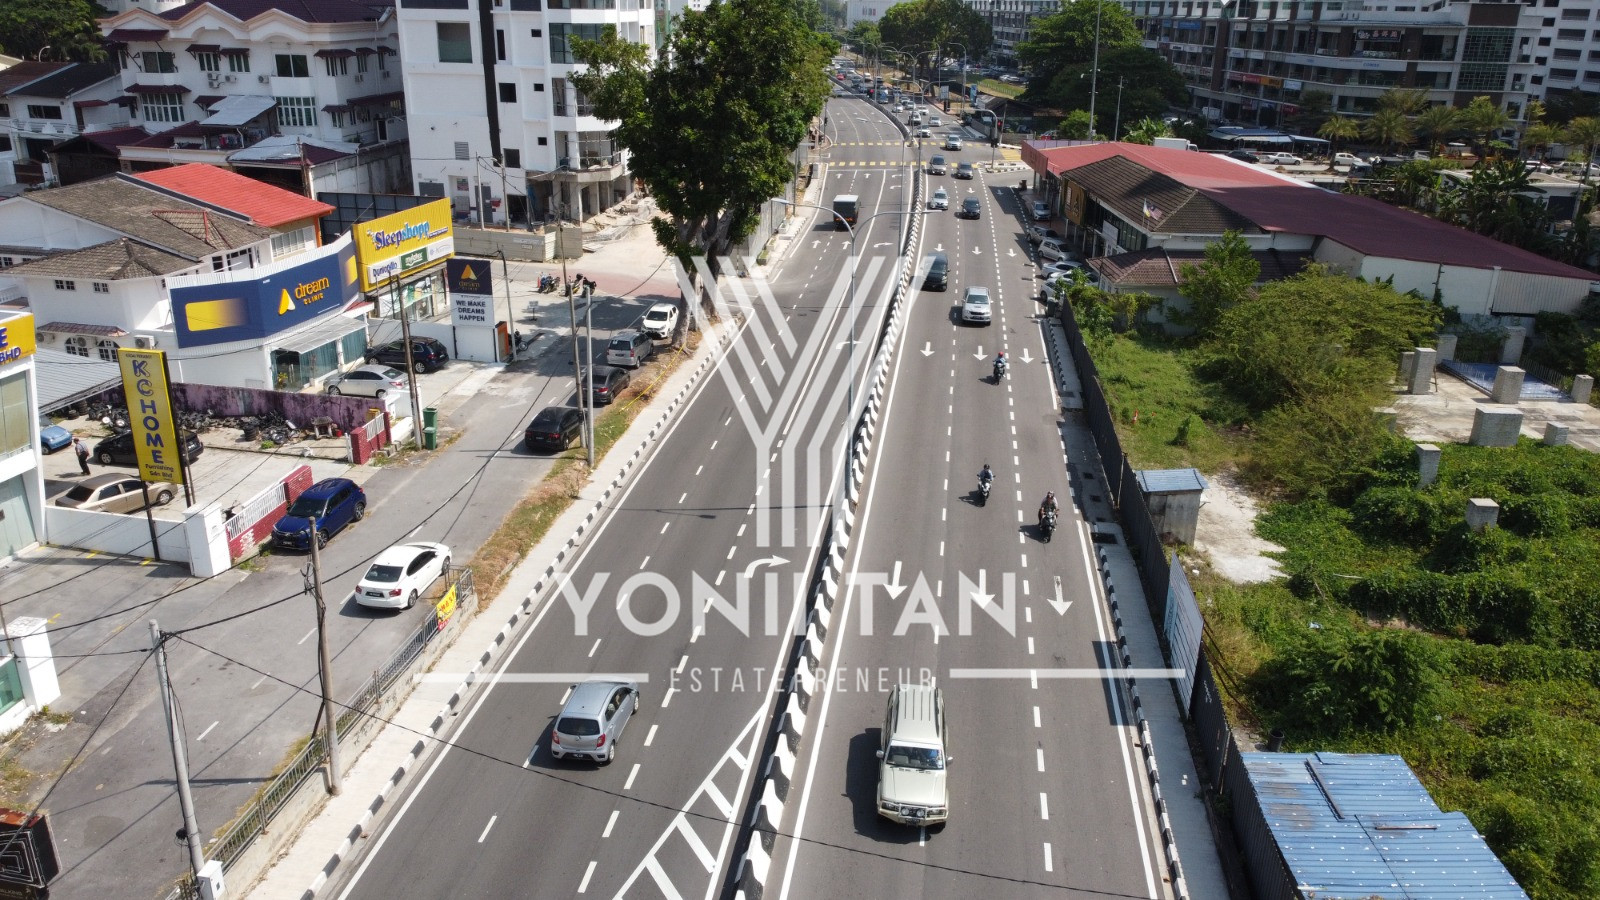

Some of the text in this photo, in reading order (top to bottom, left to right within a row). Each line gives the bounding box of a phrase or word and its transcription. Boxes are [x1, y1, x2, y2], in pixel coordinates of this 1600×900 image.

[374, 221, 430, 250] Sleepshopp
[295, 277, 330, 299] dream
[303, 293, 324, 305] CLINIC
